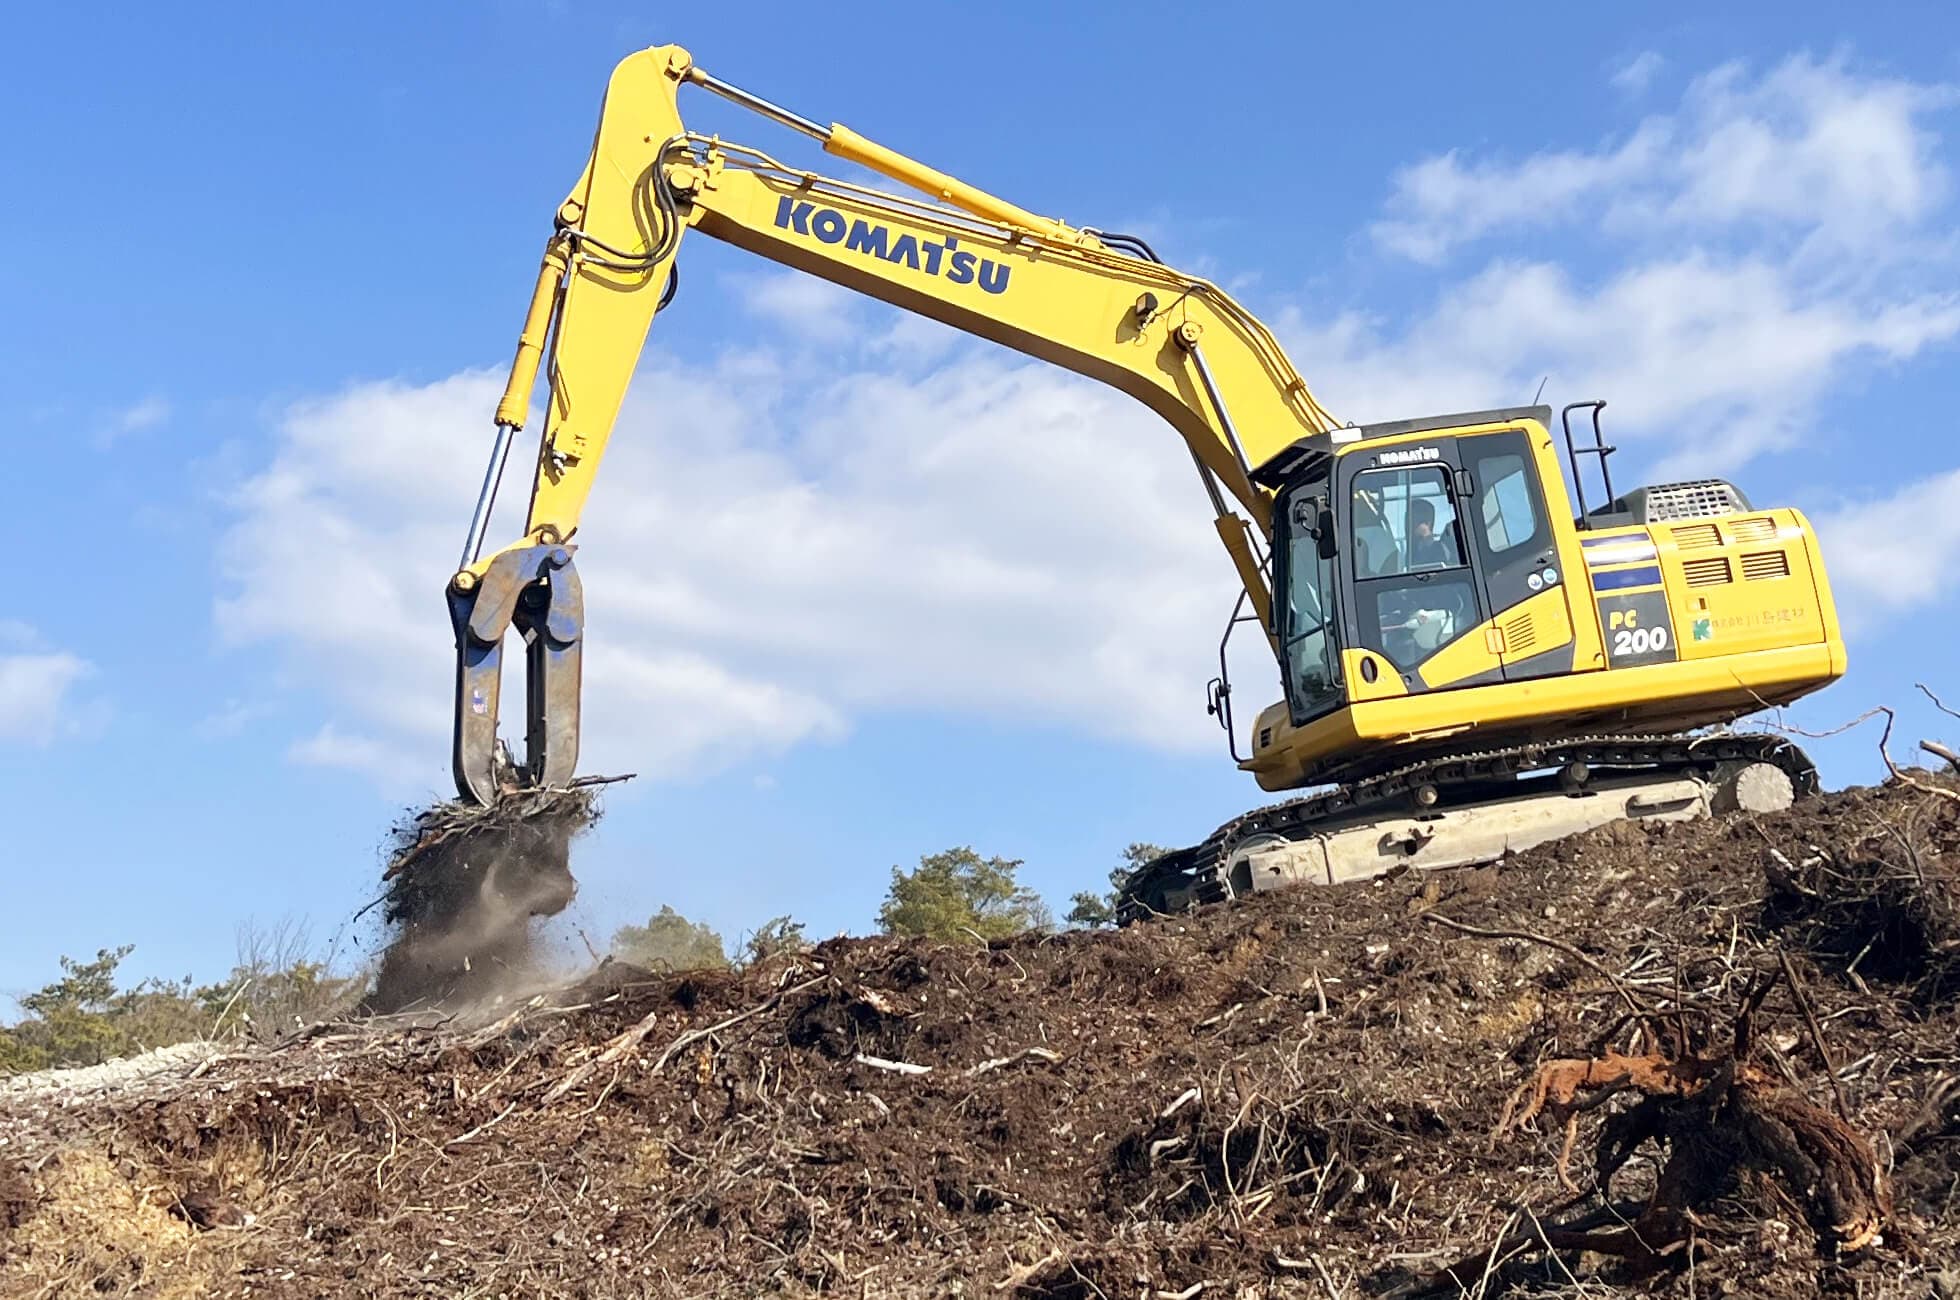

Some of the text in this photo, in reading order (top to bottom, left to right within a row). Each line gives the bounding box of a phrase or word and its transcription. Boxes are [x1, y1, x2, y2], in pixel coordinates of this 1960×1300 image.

[774, 195, 1011, 294] KOMATSU
[1379, 446, 1440, 464] KOMATSU
[1609, 609, 1637, 630] PC
[1613, 626, 1668, 656] 200
